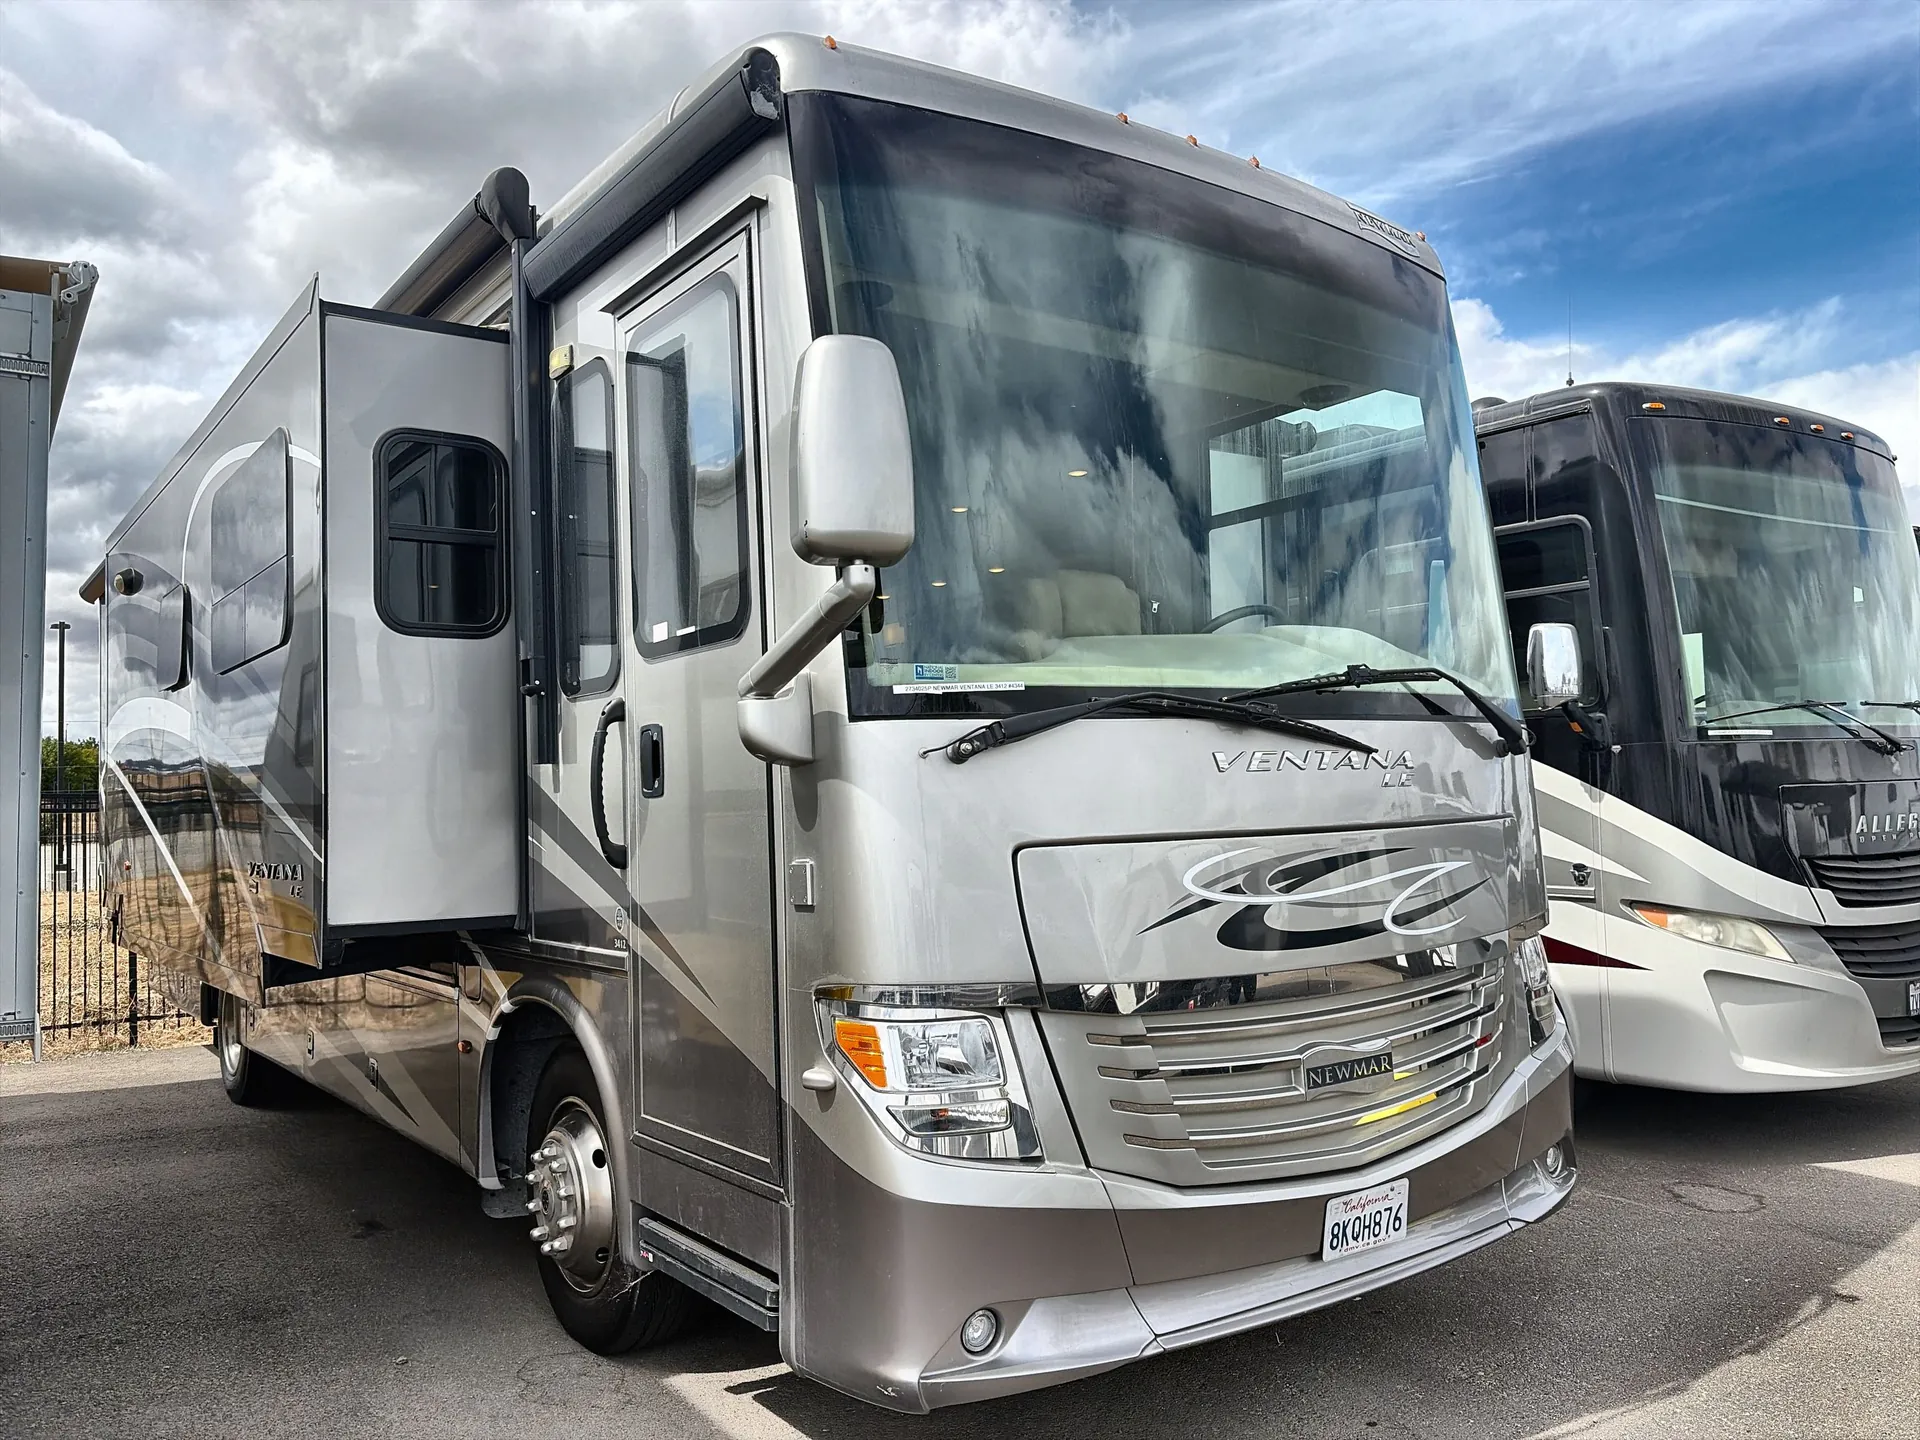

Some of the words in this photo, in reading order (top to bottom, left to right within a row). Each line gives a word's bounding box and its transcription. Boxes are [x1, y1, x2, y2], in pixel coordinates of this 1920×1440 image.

[1212, 750, 1415, 772] VENTANA
[1381, 772, 1415, 788] LE
[1859, 834, 1897, 843] OPEN
[248, 861, 304, 881] VENTANA
[290, 885, 304, 898] LE
[614, 938, 626, 949] 3412
[1308, 1056, 1392, 1087] NEWMAR
[1342, 1194, 1394, 1214] California
[1329, 1203, 1404, 1251] 8KQH876
